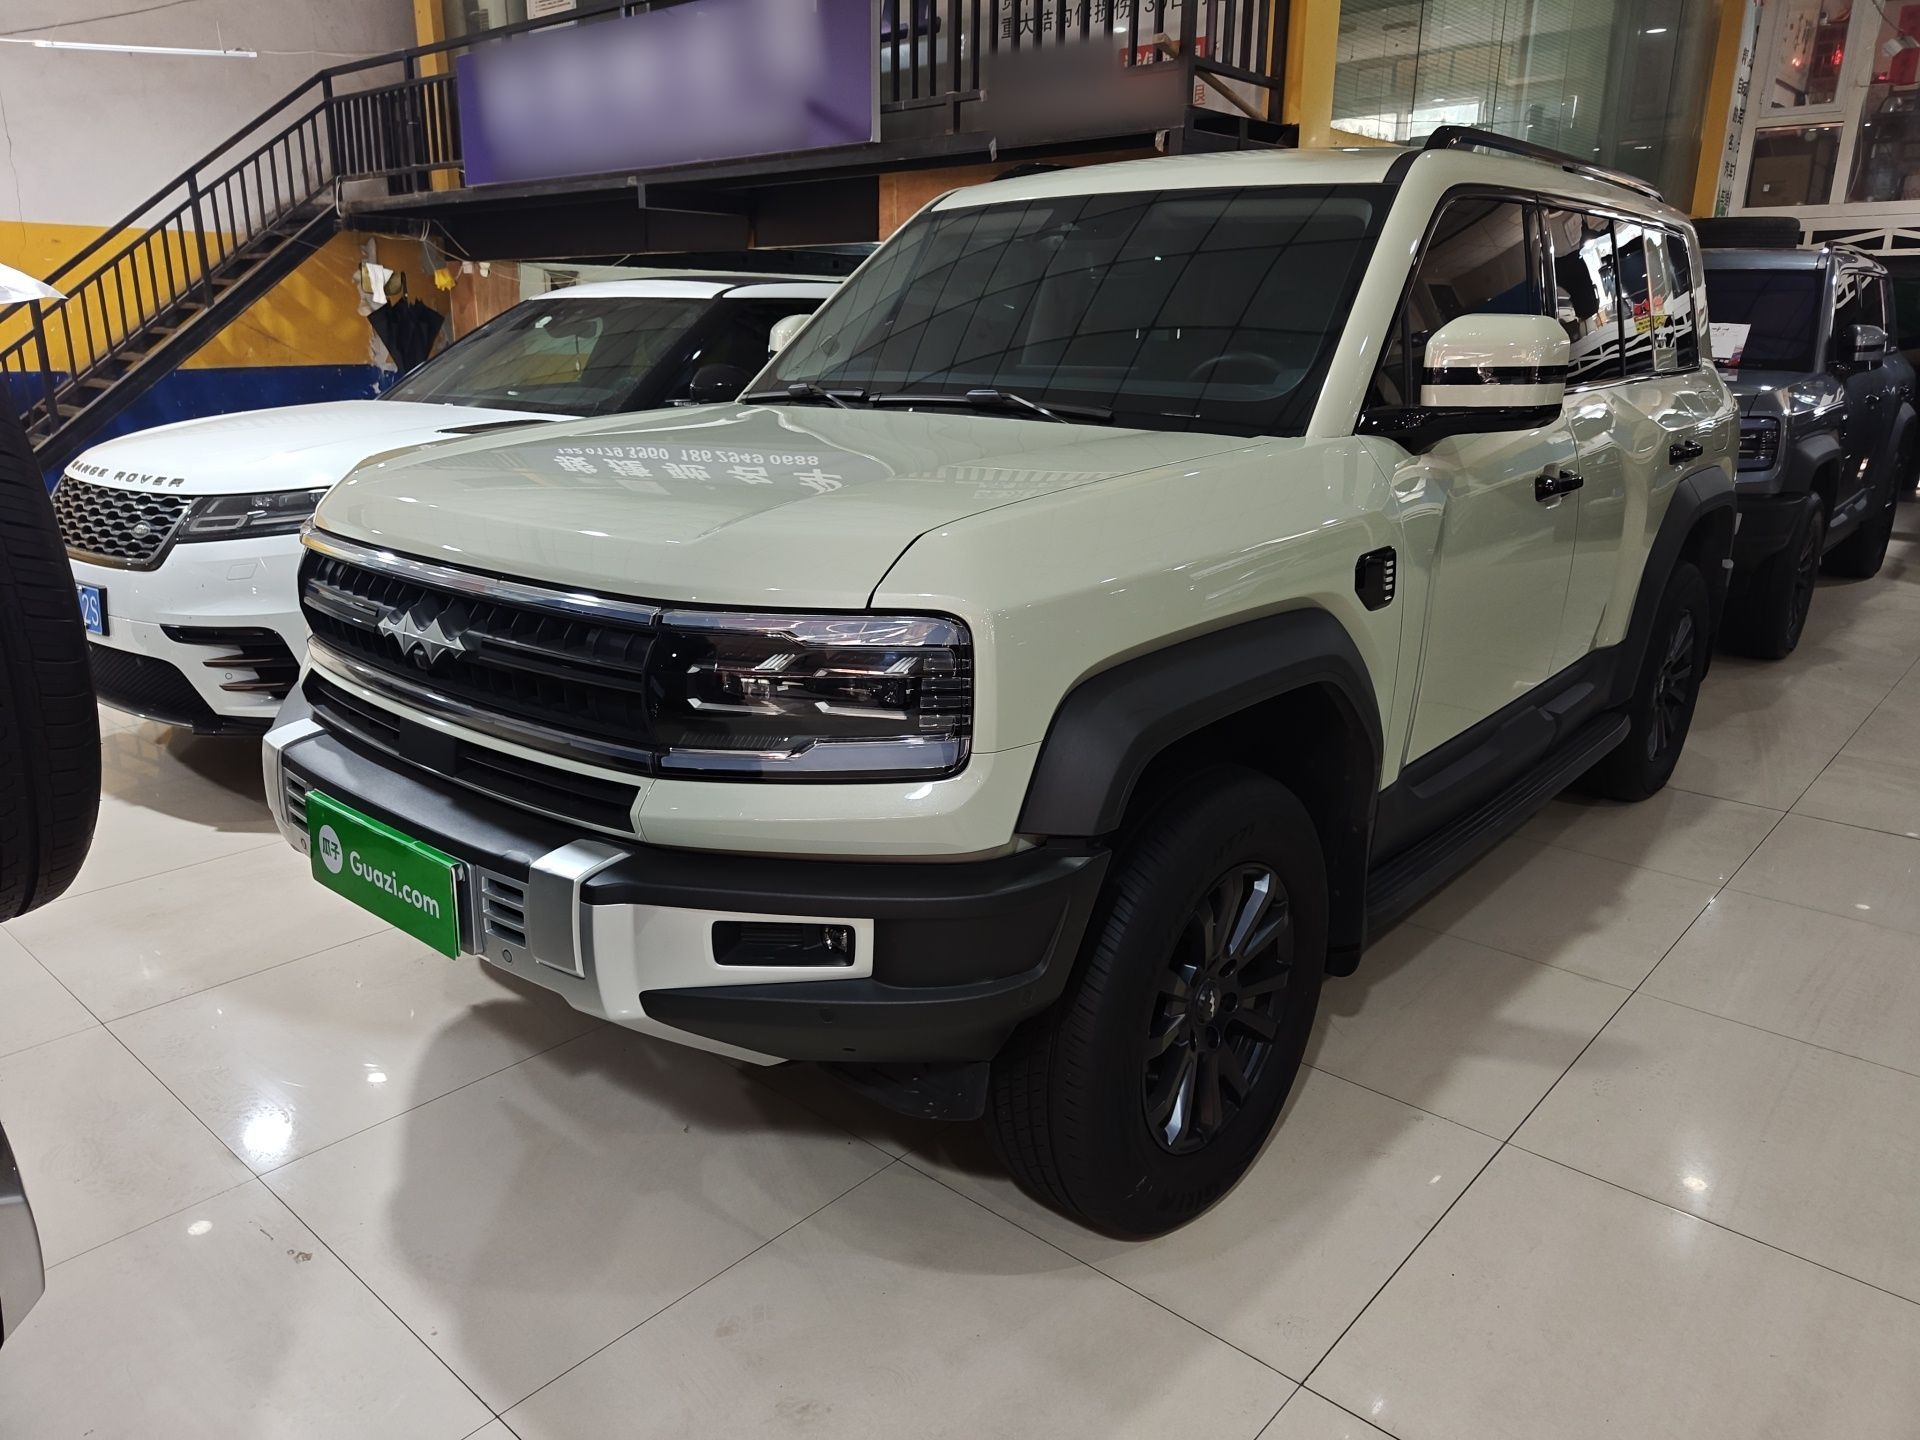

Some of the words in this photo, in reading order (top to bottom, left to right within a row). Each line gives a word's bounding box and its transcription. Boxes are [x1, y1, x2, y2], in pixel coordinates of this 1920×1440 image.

[71, 460, 108, 478] RANGE
[114, 470, 185, 488] ROVER
[321, 836, 341, 861] 瓜子
[350, 850, 440, 919] Guazi.com
